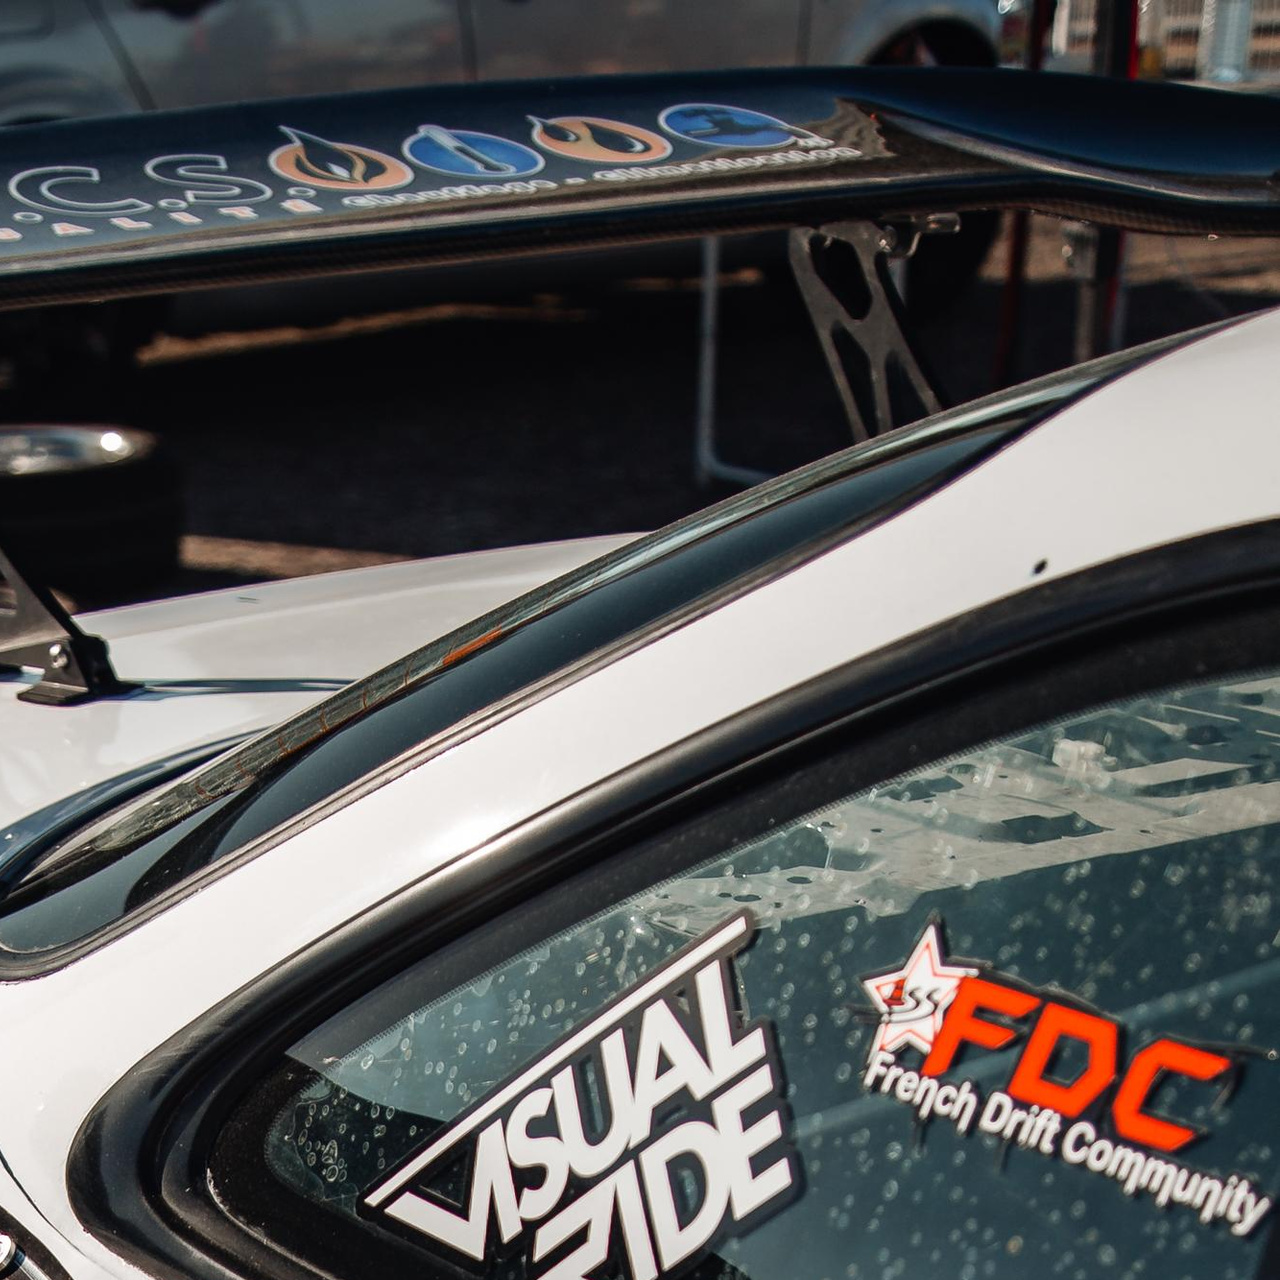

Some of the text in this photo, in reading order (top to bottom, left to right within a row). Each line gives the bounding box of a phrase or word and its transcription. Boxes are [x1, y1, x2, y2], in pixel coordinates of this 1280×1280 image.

[863, 1049, 1272, 1237] French Drift Community
[921, 976, 1232, 1152] FDC
